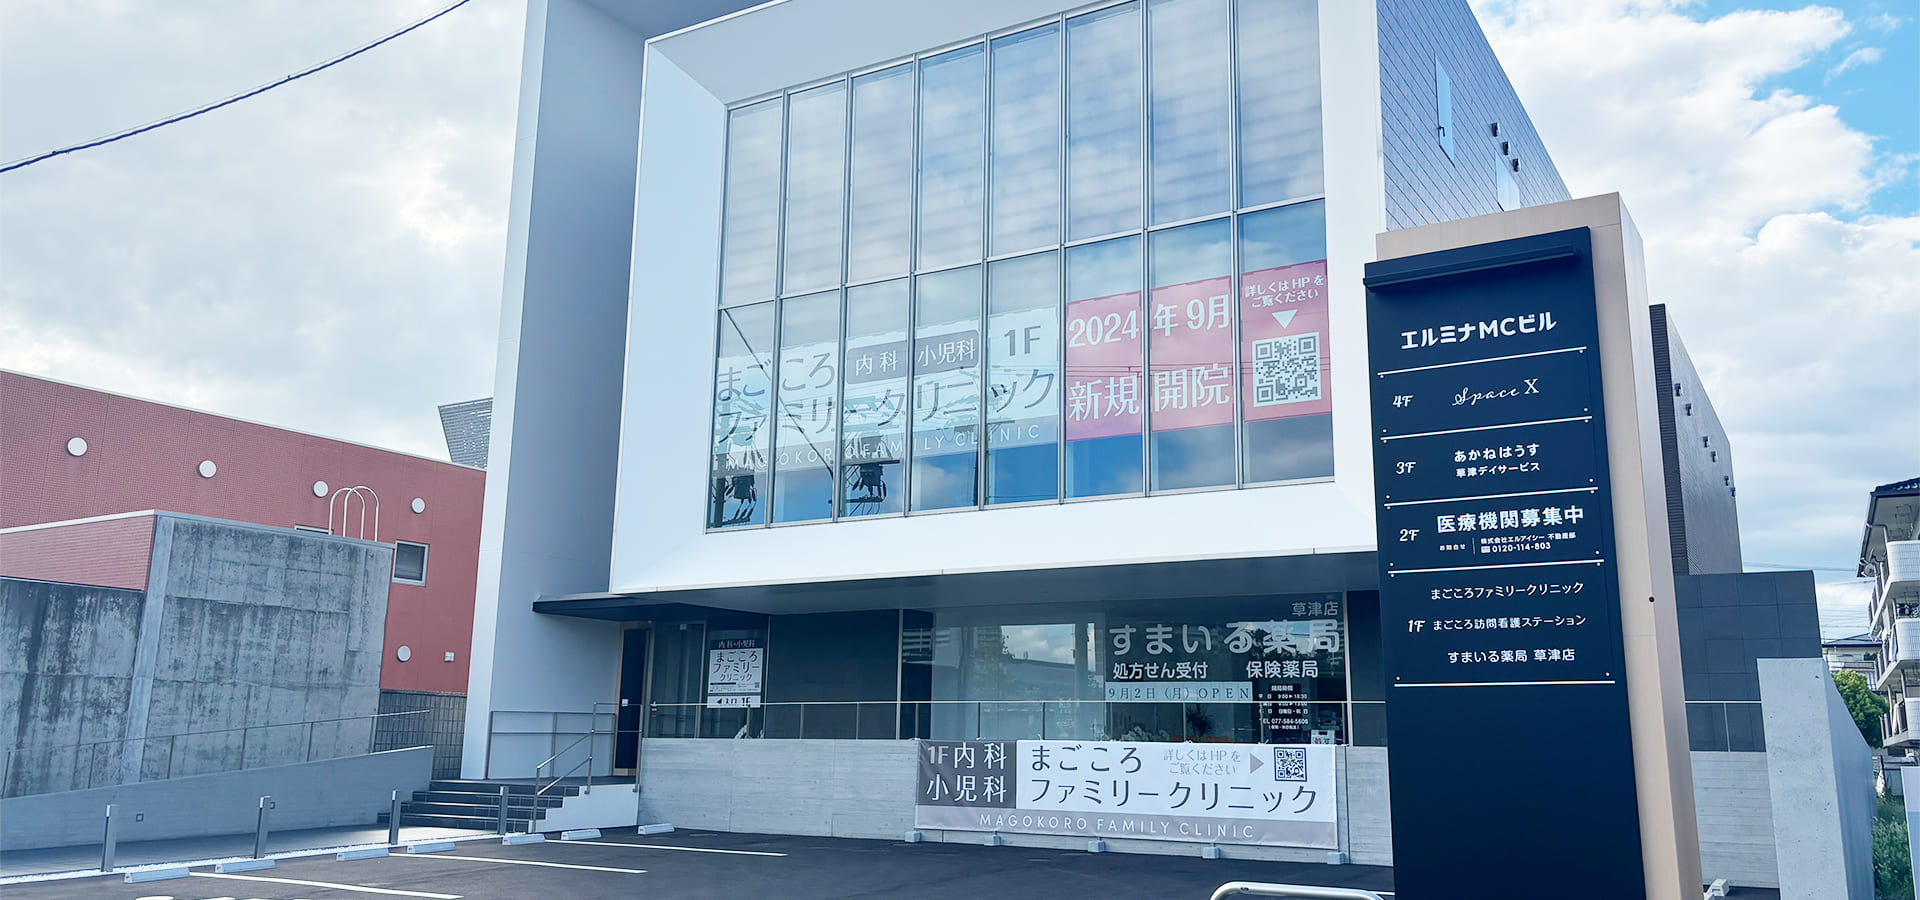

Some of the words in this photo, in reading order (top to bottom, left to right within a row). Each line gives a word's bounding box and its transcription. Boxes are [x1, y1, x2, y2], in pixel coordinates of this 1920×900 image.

[1252, 289, 1319, 308] ご覧ください
[1401, 311, 1557, 350] エルミナMCビル
[1004, 325, 1041, 357] 1F
[855, 349, 899, 377] 内科
[917, 338, 976, 367] 小児科
[717, 352, 835, 402] まごころ
[1393, 395, 1414, 408] 4F
[1452, 386, 1519, 407] Space
[1524, 378, 1539, 395] X
[863, 435, 946, 457] FAMILY
[955, 424, 1040, 447] CLINIC
[1454, 442, 1540, 464] あかねはうす
[1395, 461, 1417, 475] 3F
[1456, 462, 1541, 479] 草津デイサービス
[1437, 505, 1585, 534] 医療機関募集中
[1399, 528, 1420, 542] 2F
[1491, 541, 1551, 553] 0120-114-803
[1431, 581, 1584, 600] まごころファミリークリニック
[1292, 601, 1339, 617] 草津店
[1408, 620, 1425, 633] 1F
[1433, 614, 1587, 631] まごころ訪問看護ステーション
[1108, 618, 1340, 656] すまいる薬局
[715, 650, 758, 663] まごころ
[1447, 649, 1528, 664] すまいる薬局
[1533, 648, 1576, 662] 草津店
[713, 661, 760, 674] ファミリー
[1113, 662, 1208, 680] 処方せん受付
[1245, 660, 1319, 679] 保険薬局
[720, 673, 753, 682] クリニック
[1030, 746, 1143, 774] まごころ
[1169, 762, 1236, 776] ご覧ください
[926, 777, 1008, 803] 小児科
[1030, 777, 1318, 815] ファミリークリニック
[979, 813, 1088, 831] MAGOKORO
[1096, 818, 1170, 836] FAMILY
[1179, 822, 1256, 839] CLINIC
